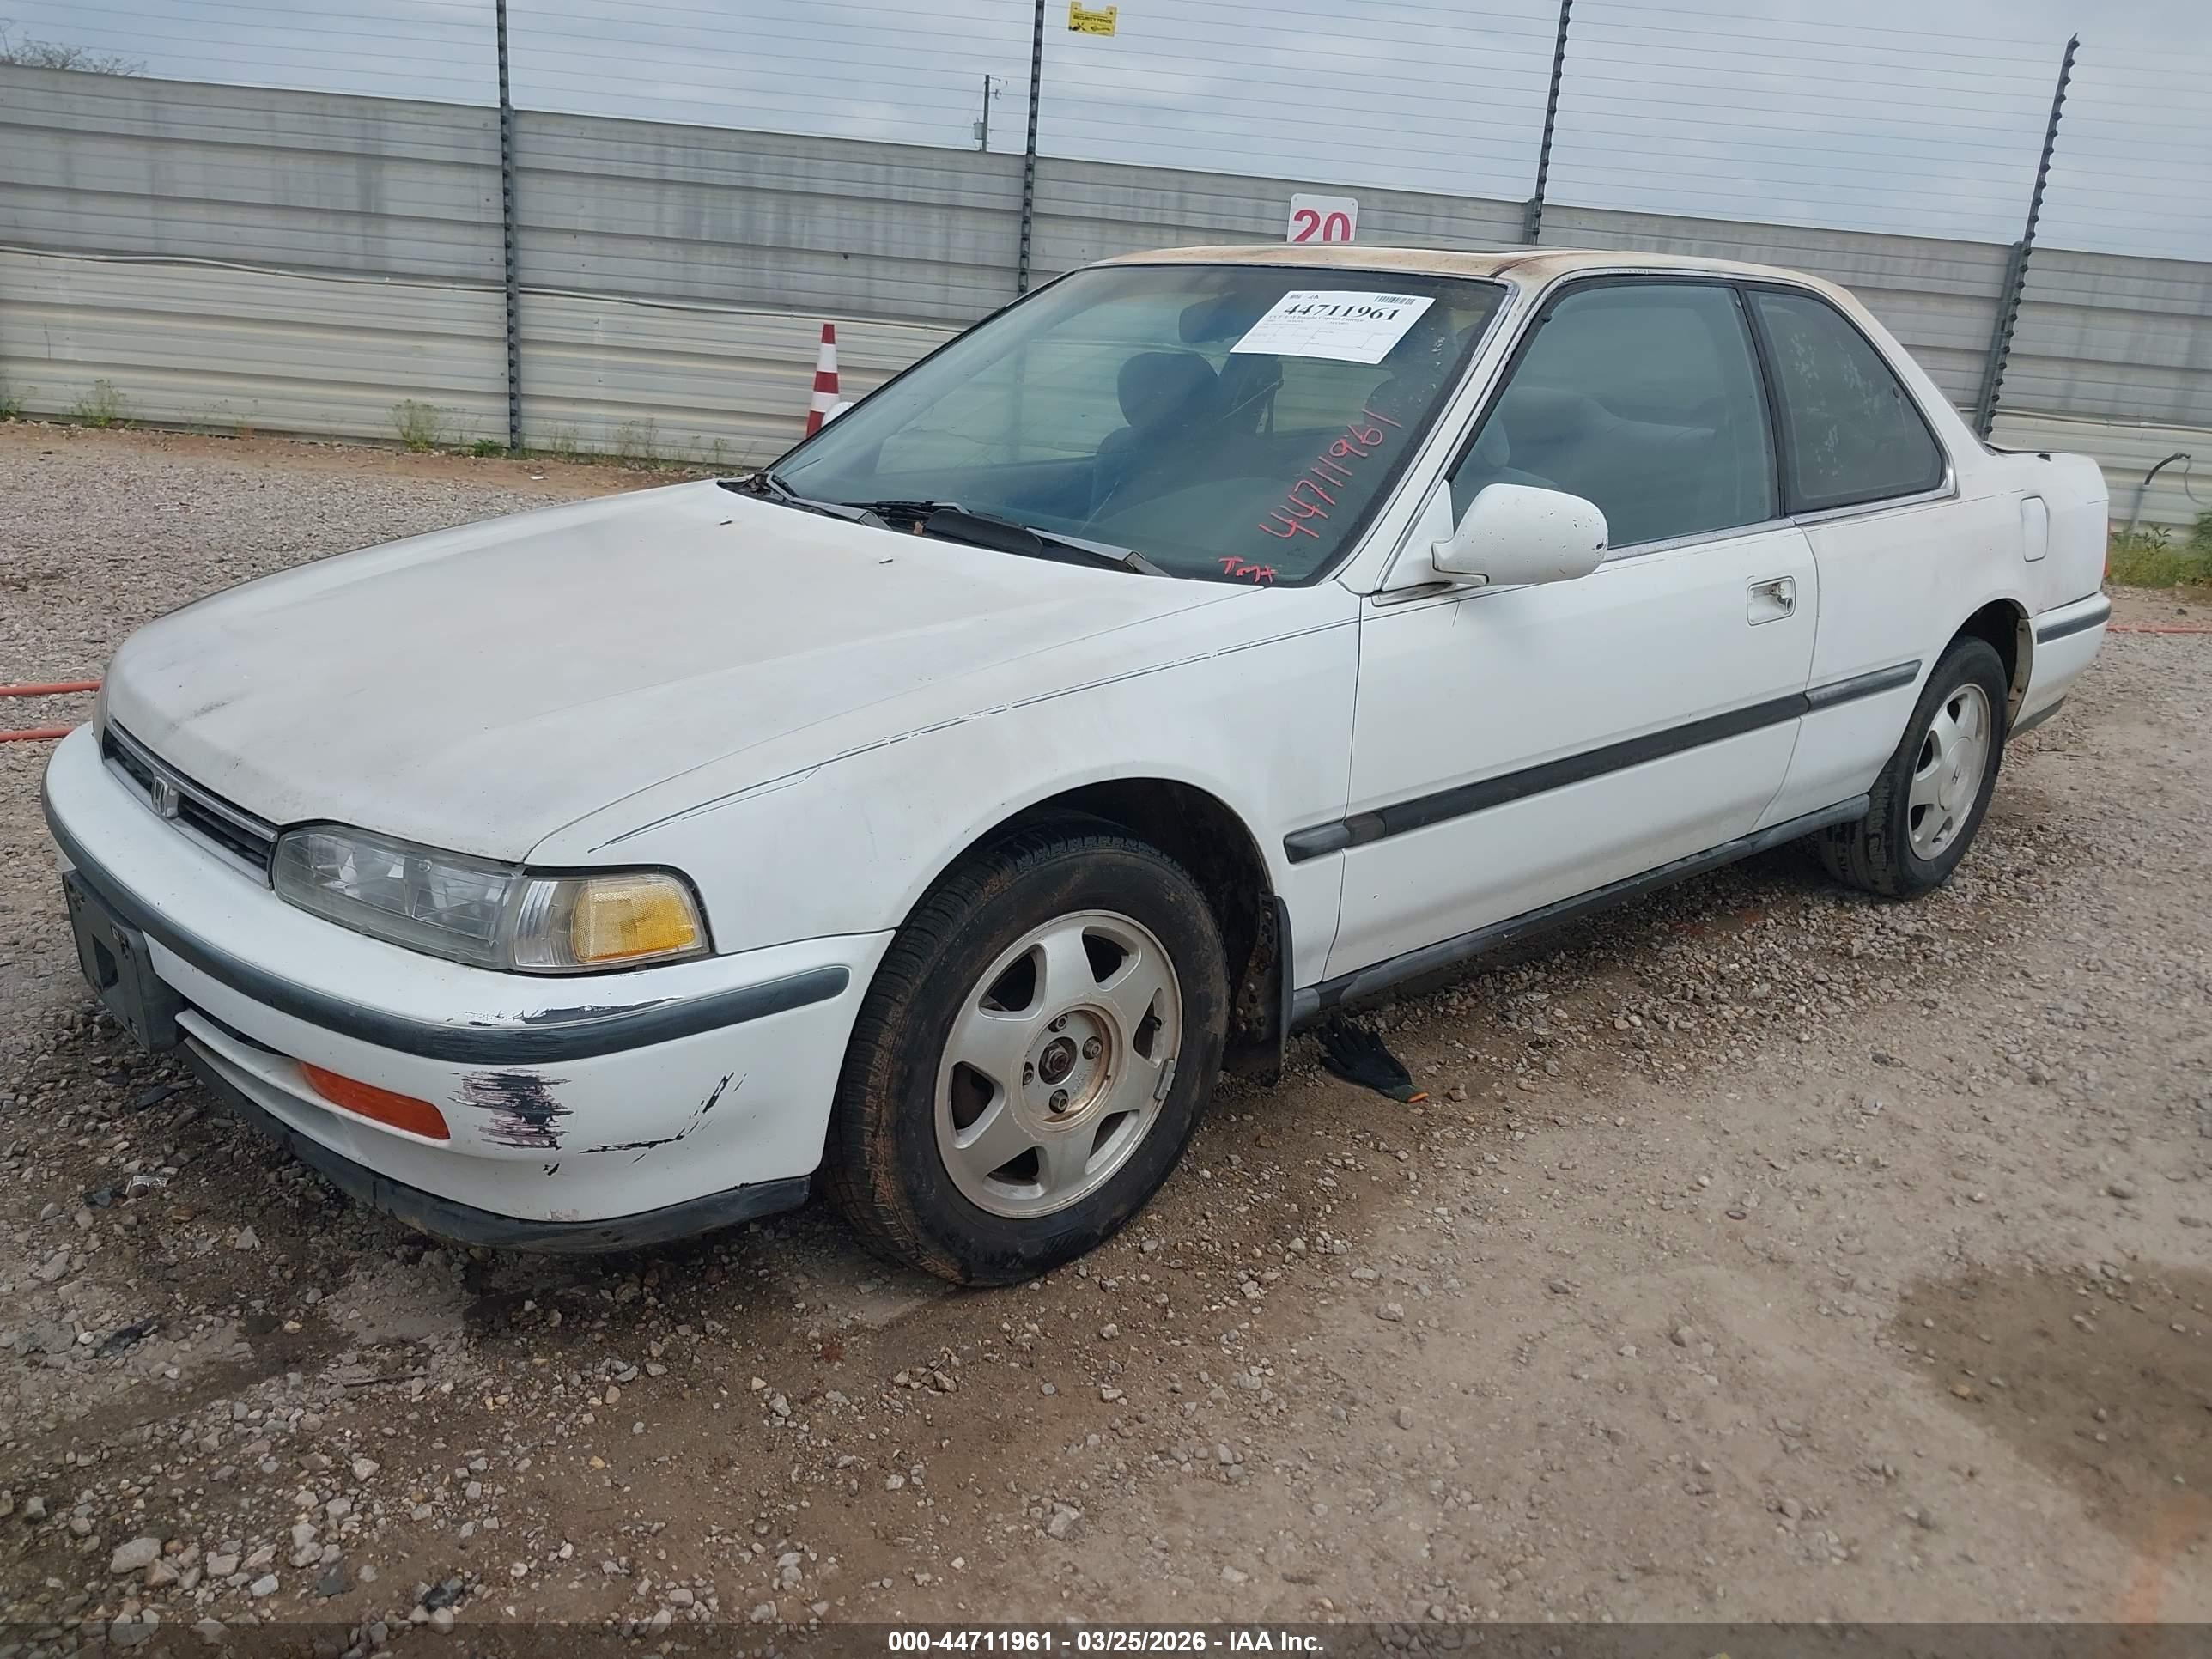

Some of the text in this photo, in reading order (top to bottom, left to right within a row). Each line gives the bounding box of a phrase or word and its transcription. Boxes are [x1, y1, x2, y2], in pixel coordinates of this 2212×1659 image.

[1293, 209, 1352, 242] 20
[1284, 302, 1401, 322] 44711961
[1259, 408, 1402, 538] 44711961
